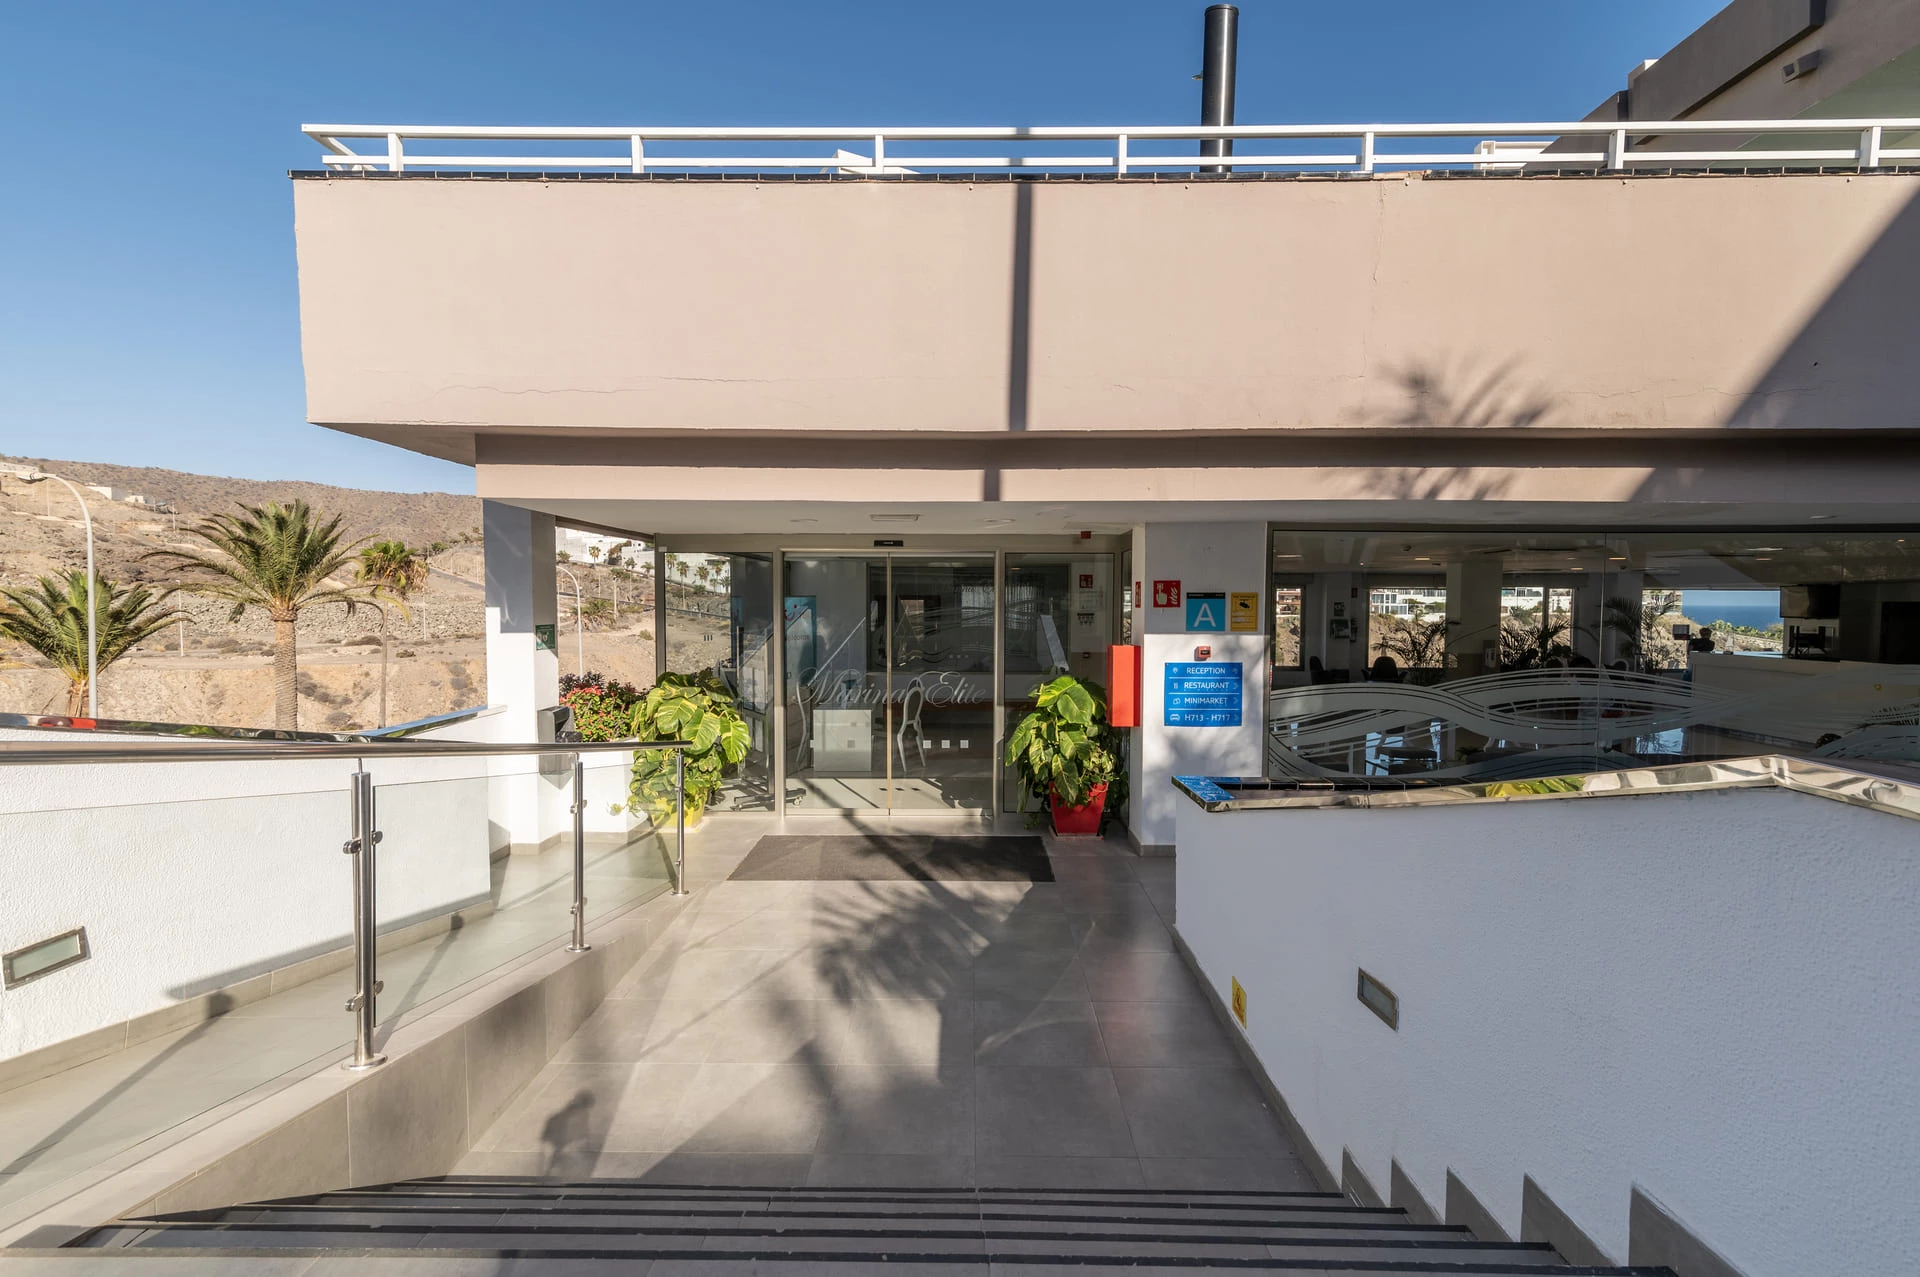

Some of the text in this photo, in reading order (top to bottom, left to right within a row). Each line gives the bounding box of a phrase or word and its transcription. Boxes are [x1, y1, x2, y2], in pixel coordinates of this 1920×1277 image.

[1193, 603, 1216, 628] A
[794, 667, 986, 708] Marina Elite
